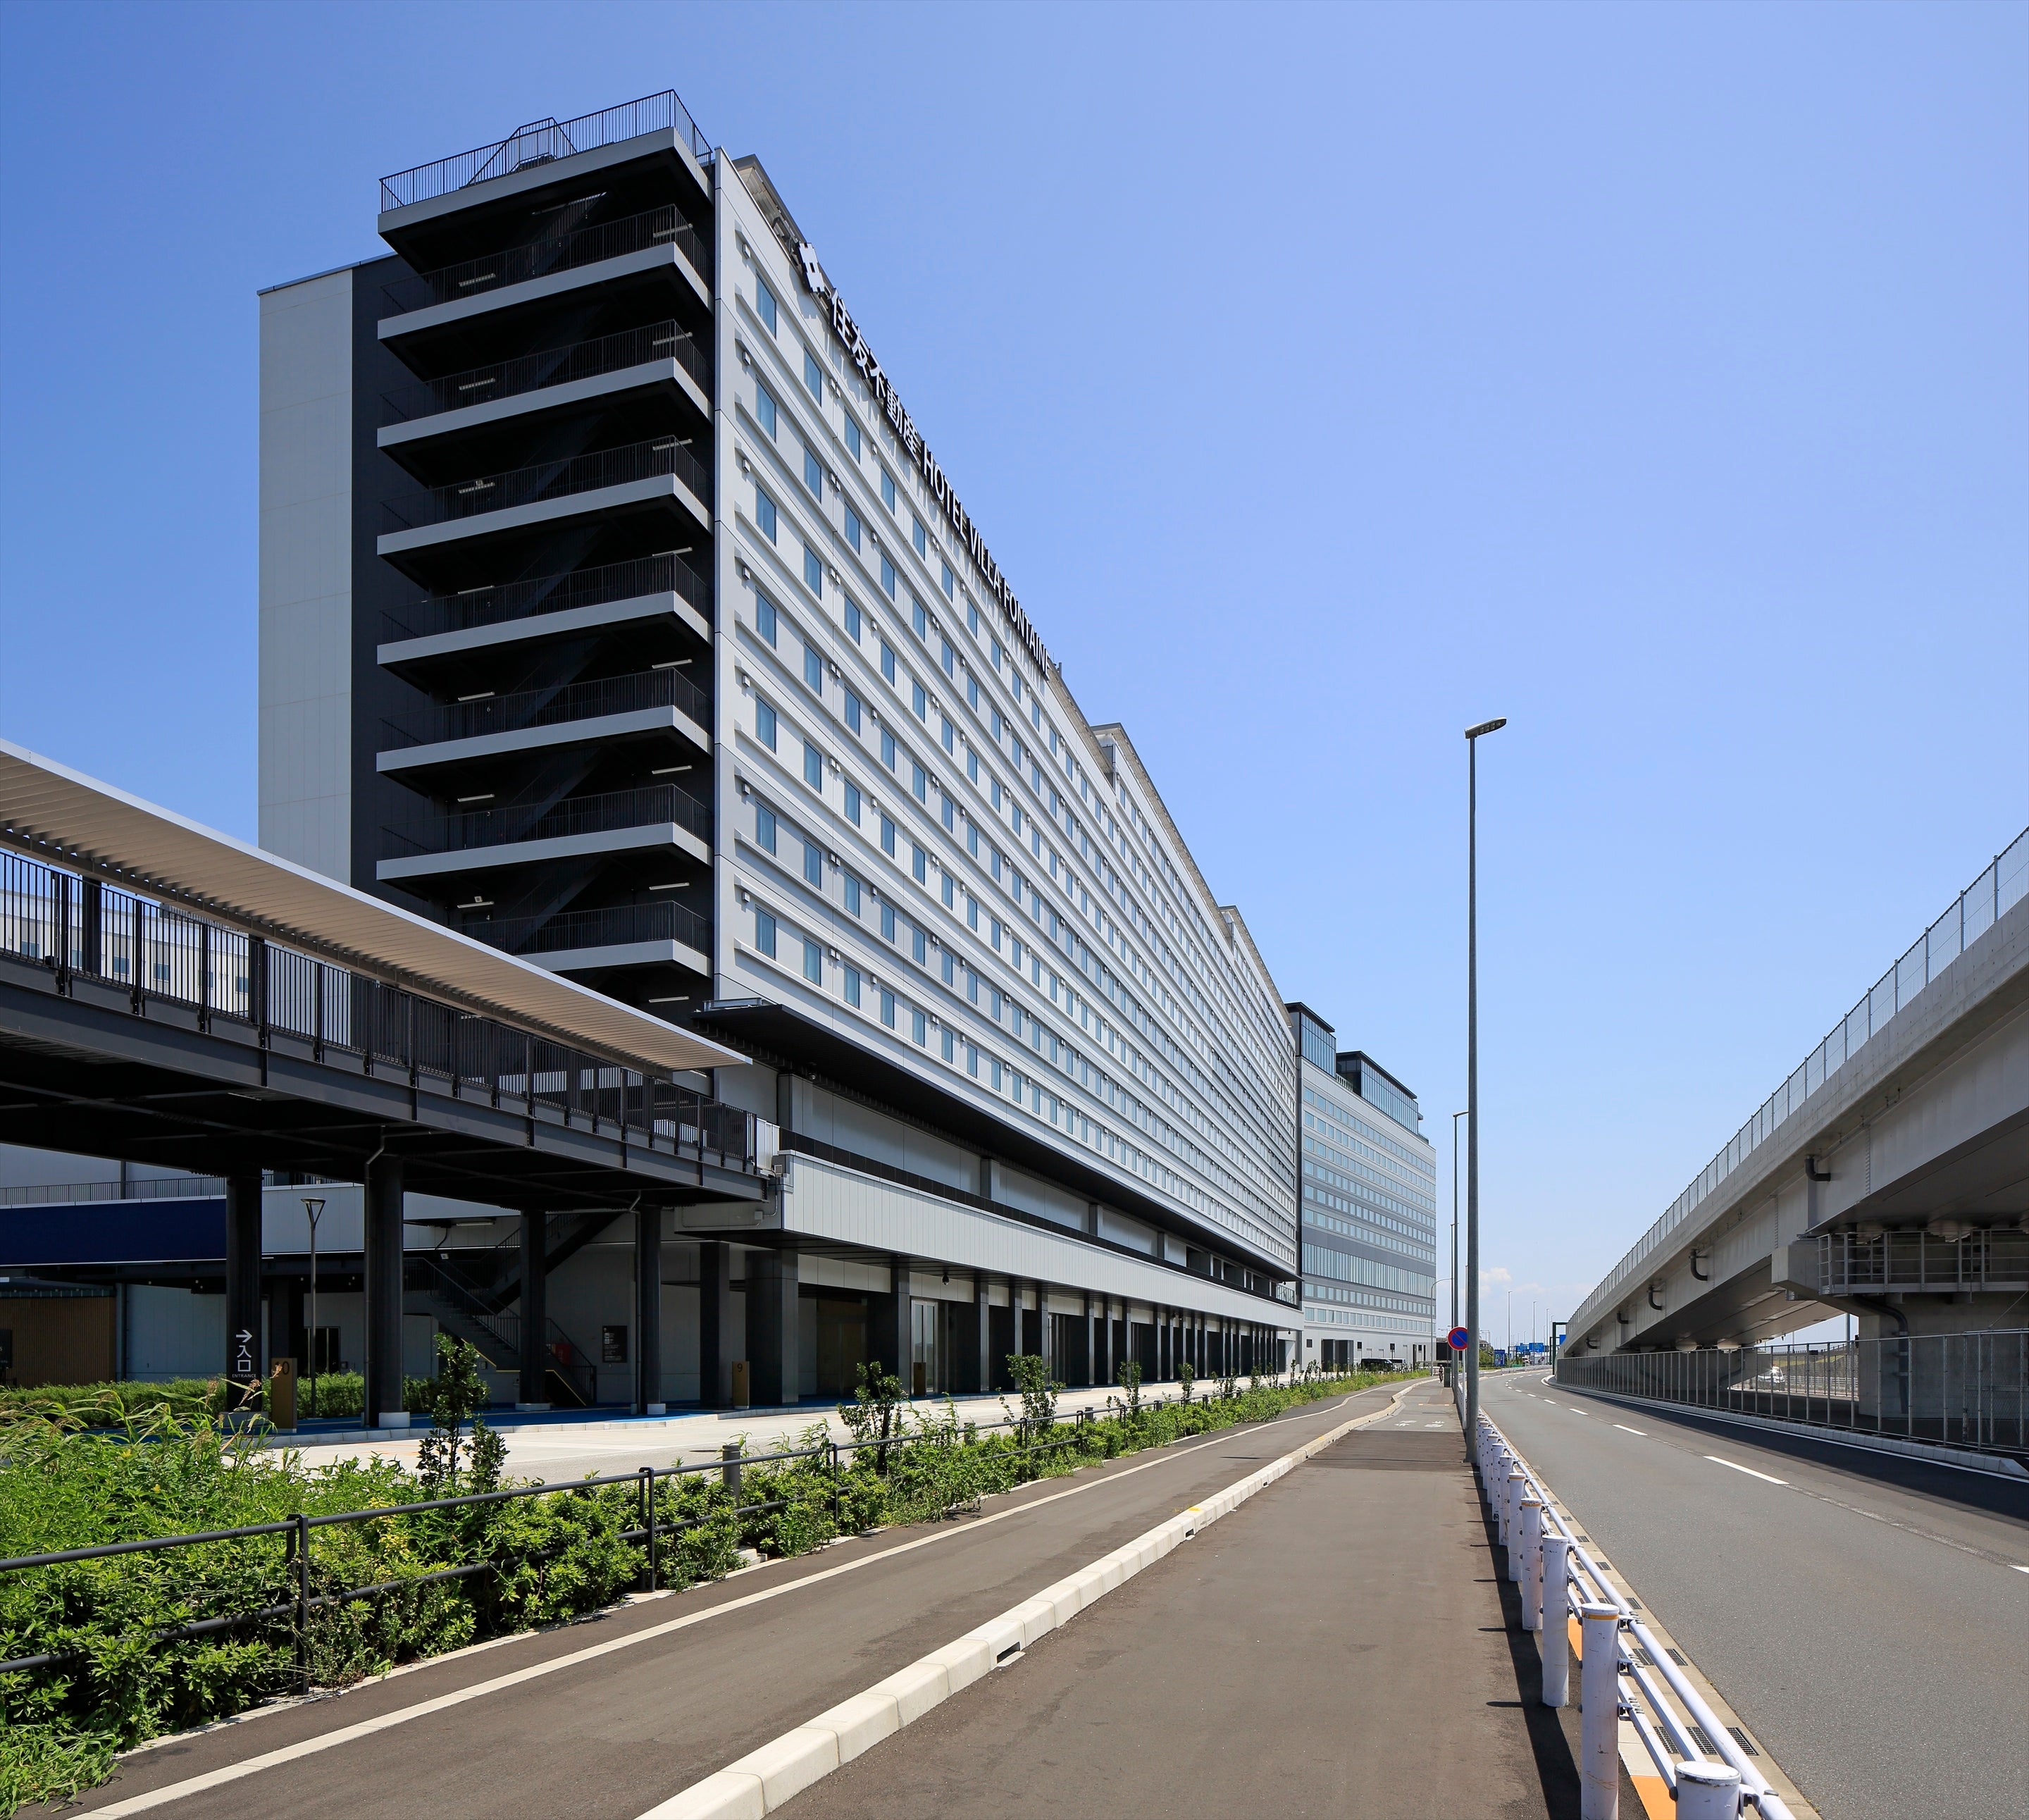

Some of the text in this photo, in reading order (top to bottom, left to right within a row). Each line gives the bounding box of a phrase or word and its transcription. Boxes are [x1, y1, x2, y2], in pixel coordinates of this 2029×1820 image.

[831, 287, 922, 468] 住友不動産
[922, 440, 1053, 681] HOTEL VILLA FONTAINE
[237, 1345, 252, 1372] 入口
[737, 1363, 743, 1373] 9
